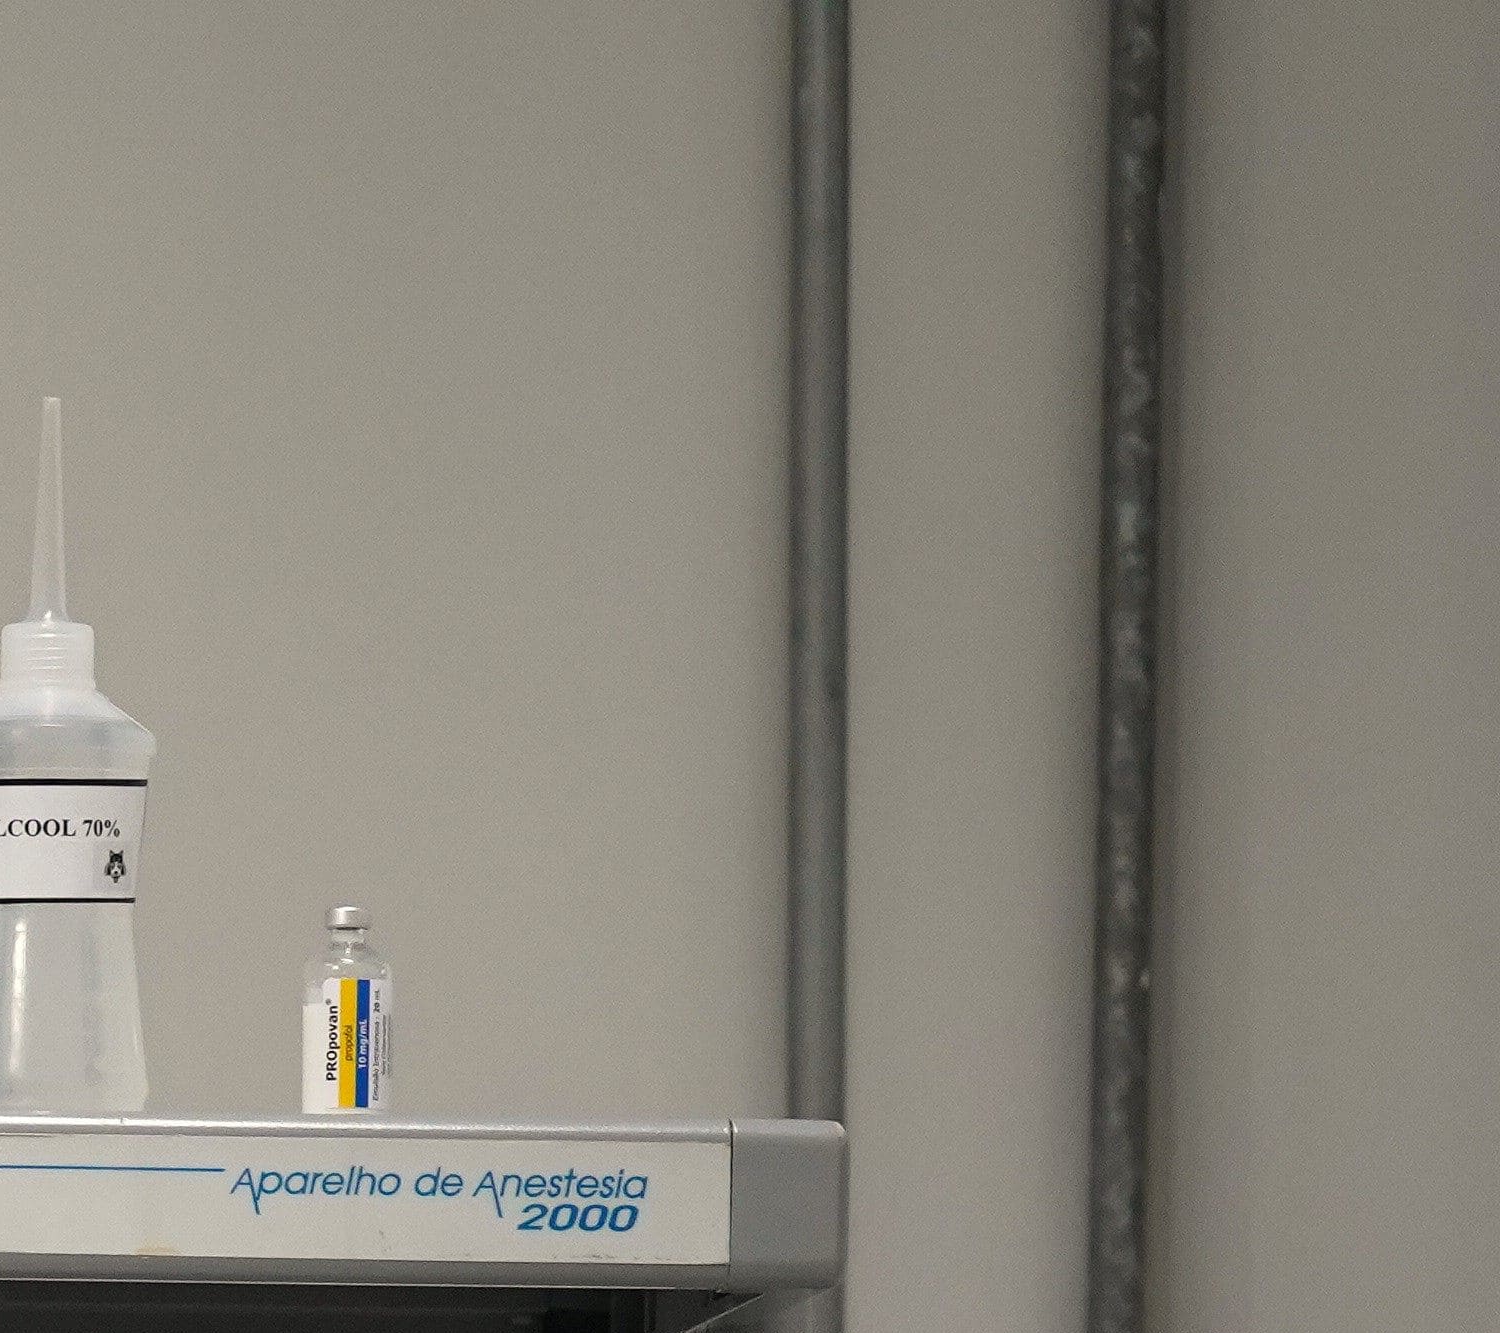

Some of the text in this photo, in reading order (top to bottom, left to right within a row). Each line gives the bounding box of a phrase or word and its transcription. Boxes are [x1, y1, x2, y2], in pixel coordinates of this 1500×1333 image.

[82, 819, 121, 839] 70%
[358, 1019, 369, 1068] 10 mg/mL
[230, 1166, 648, 1218] Aparelho de Anestesia
[517, 1204, 638, 1232] 2000
